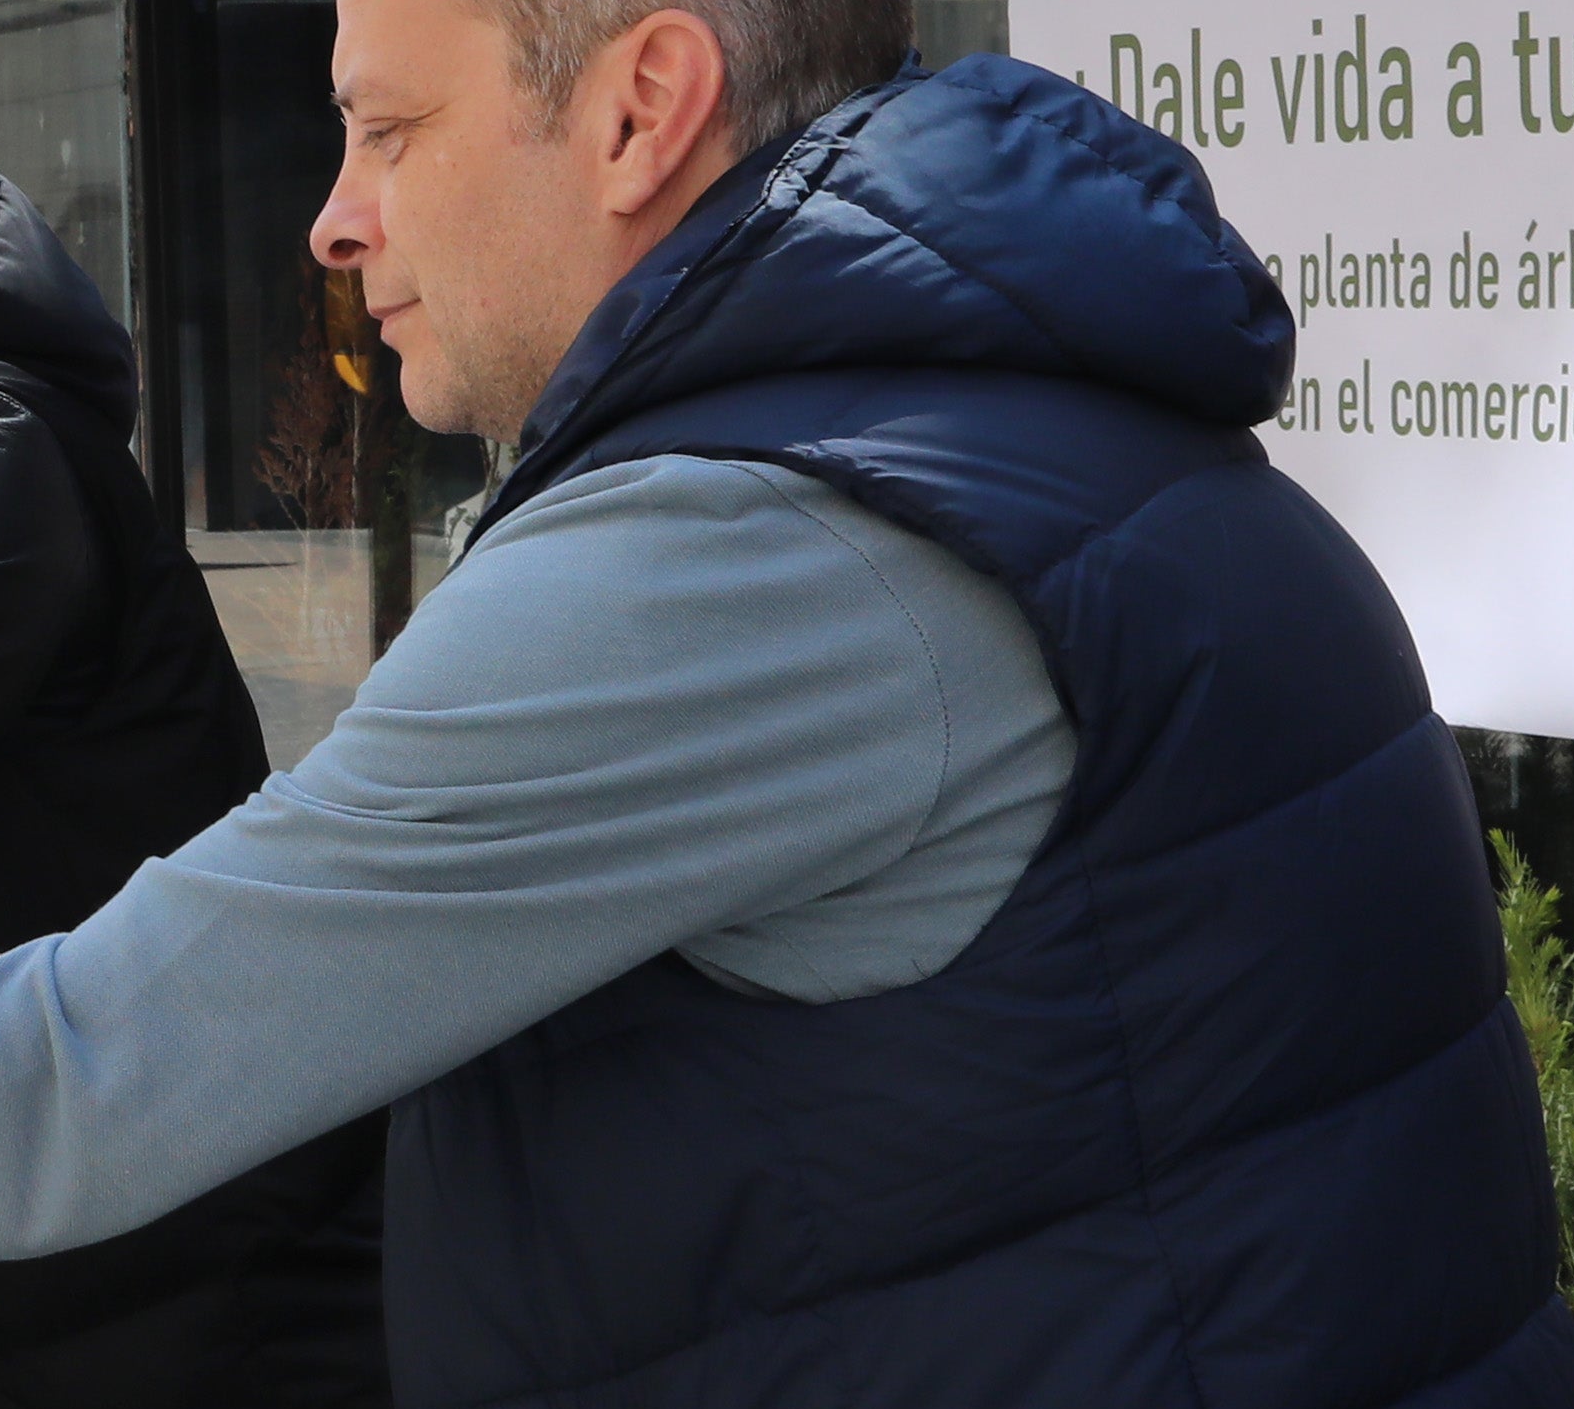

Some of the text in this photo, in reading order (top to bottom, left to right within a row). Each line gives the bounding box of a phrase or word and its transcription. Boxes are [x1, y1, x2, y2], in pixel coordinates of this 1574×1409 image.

[1110, 27, 1246, 149] Dale
[1271, 14, 1414, 144] vida
[1447, 42, 1484, 138] a
[1299, 232, 1432, 329] planta
[1449, 230, 1500, 310] de
[1338, 359, 1375, 435] el
